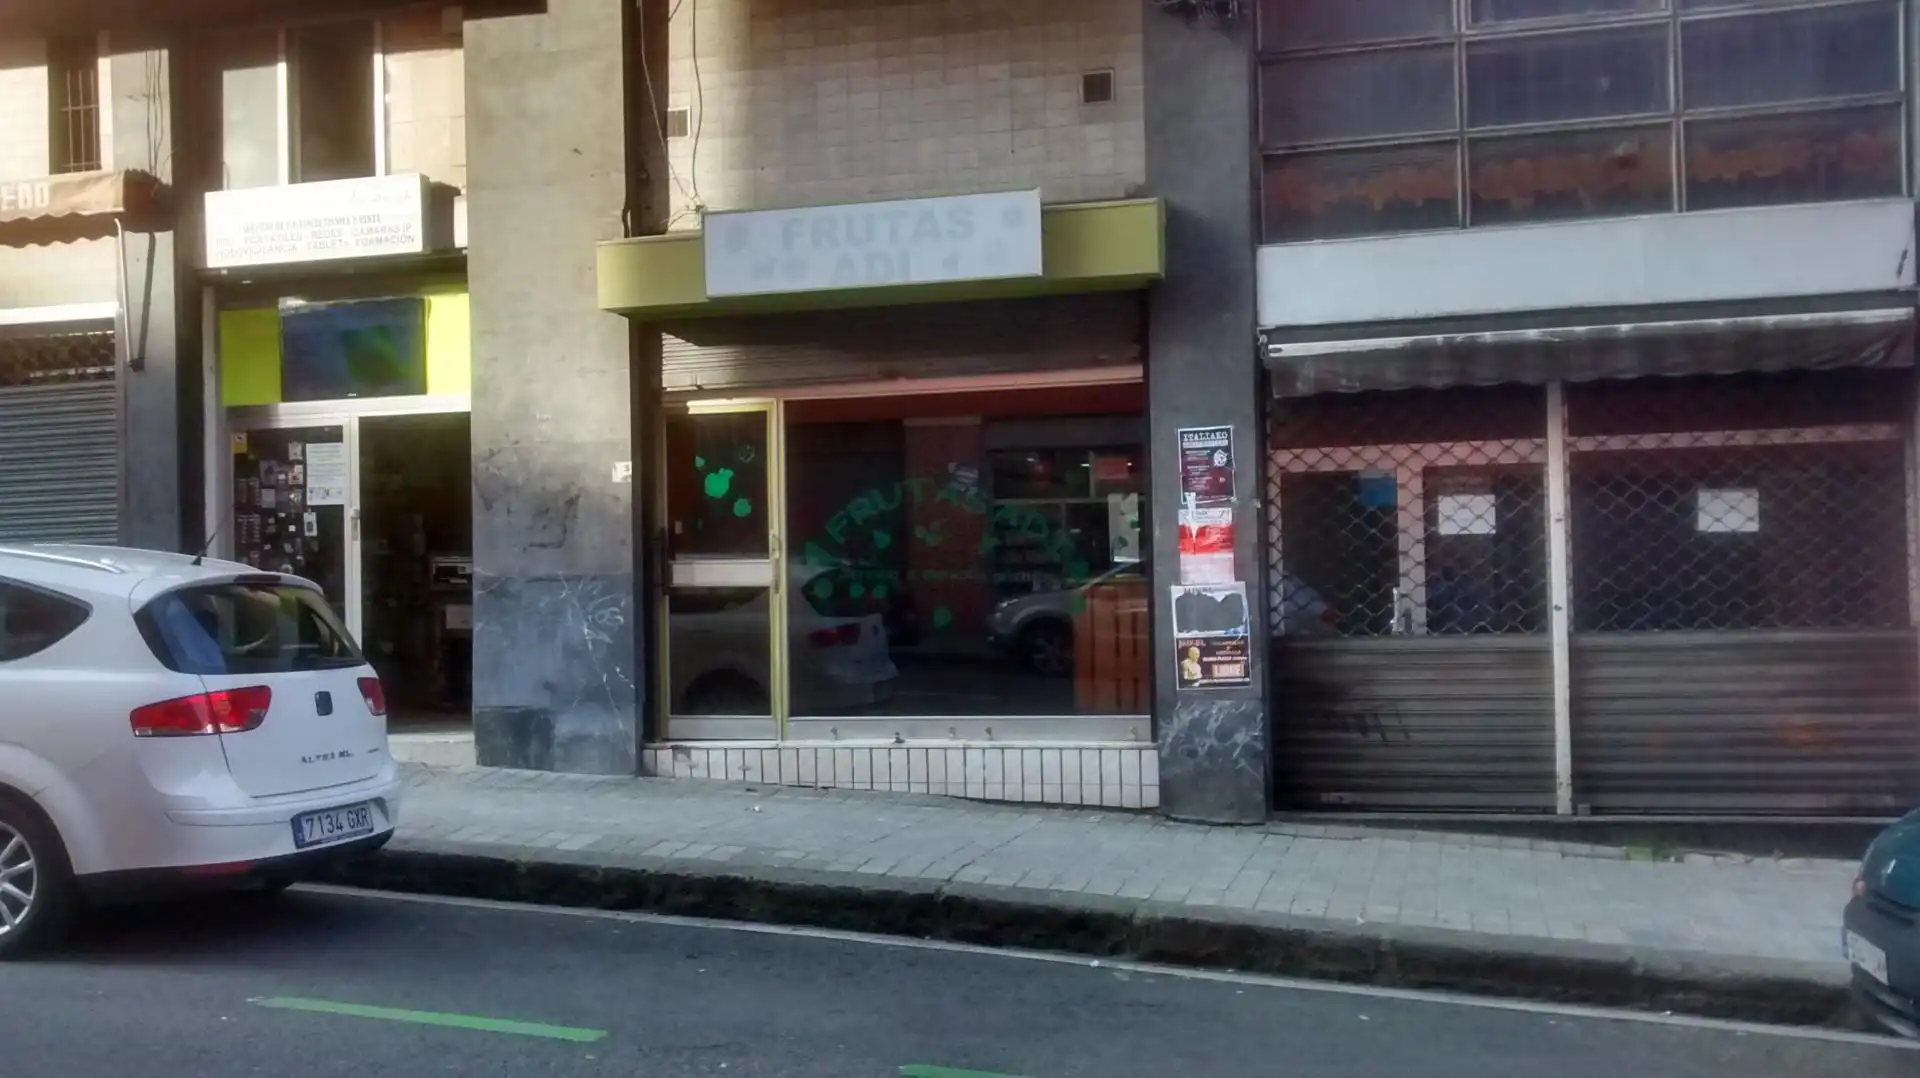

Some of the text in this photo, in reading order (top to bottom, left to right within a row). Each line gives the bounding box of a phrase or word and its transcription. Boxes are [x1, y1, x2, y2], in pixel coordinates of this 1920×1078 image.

[781, 204, 976, 250] FRUTAS
[832, 249, 911, 284] ADI
[305, 807, 370, 841] 7134 GXR
